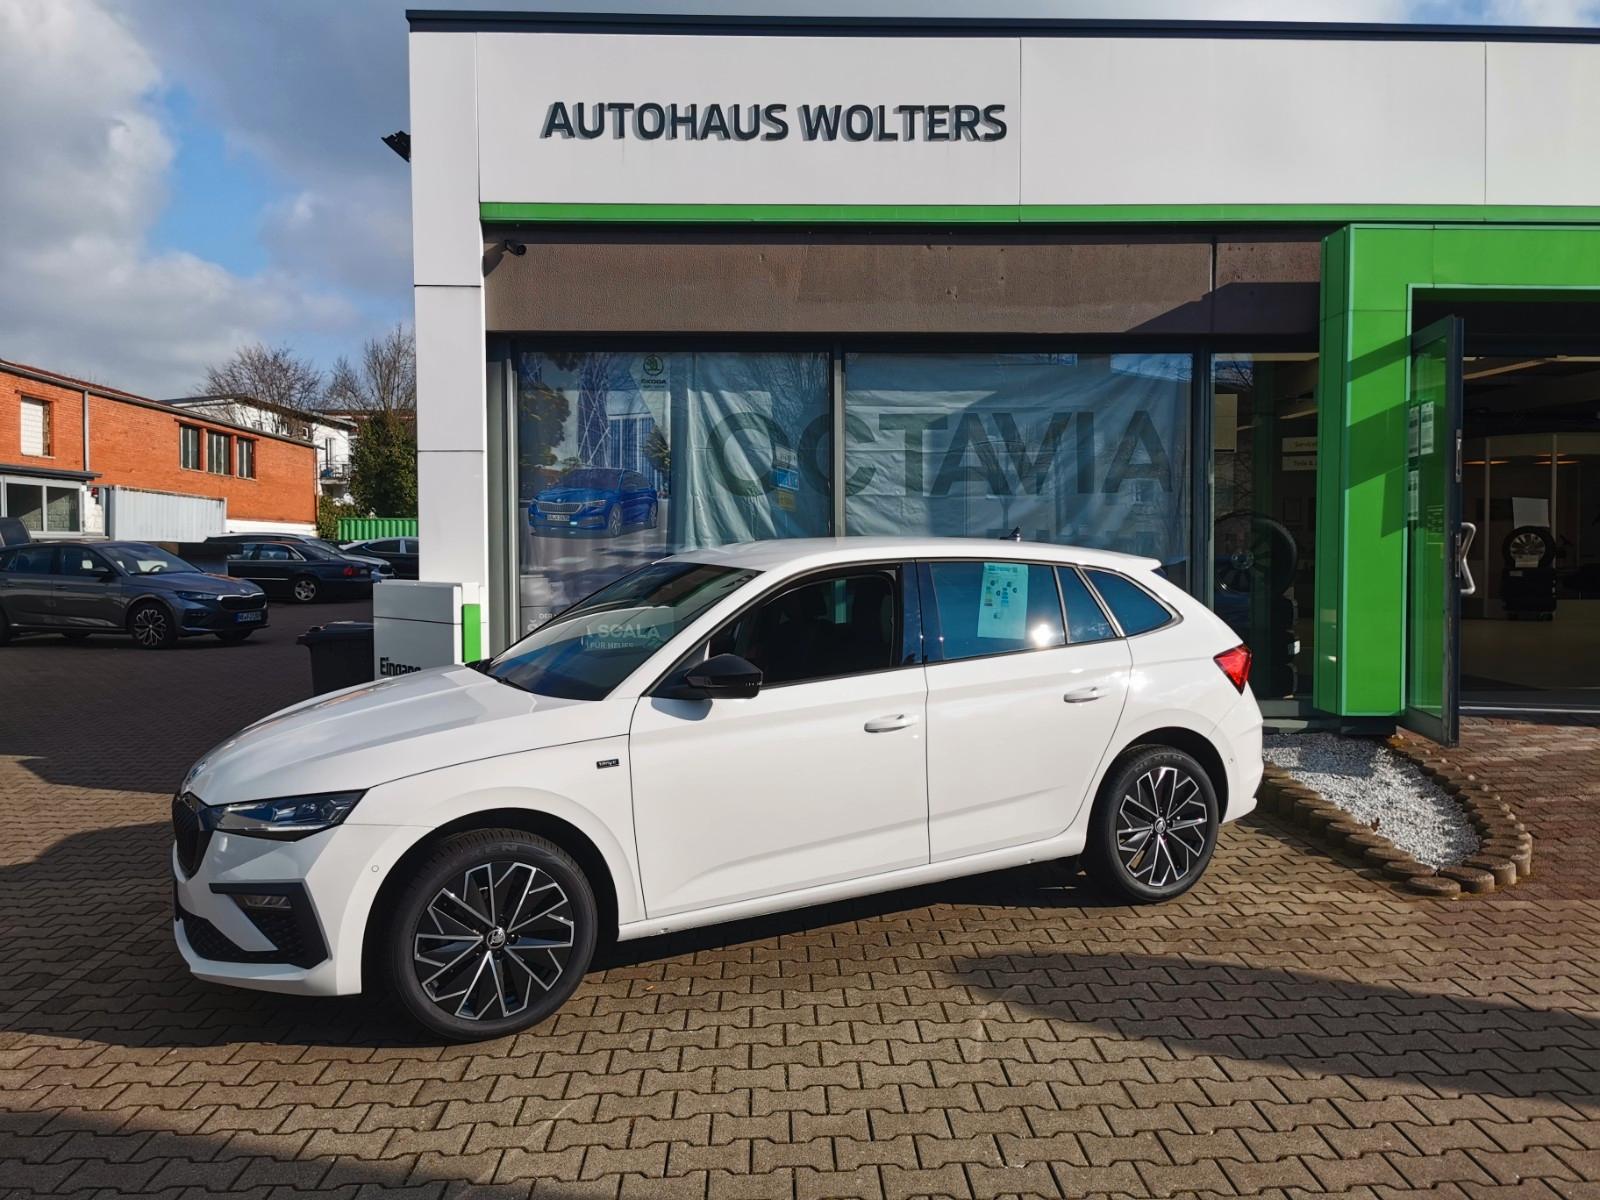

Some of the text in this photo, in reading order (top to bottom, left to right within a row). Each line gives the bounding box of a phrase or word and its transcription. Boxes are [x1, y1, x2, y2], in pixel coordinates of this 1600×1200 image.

[544, 102, 1008, 142] AUTOHAUS WOLTERS
[705, 410, 1174, 497] OCTAVIA
[598, 624, 660, 639] SCALA
